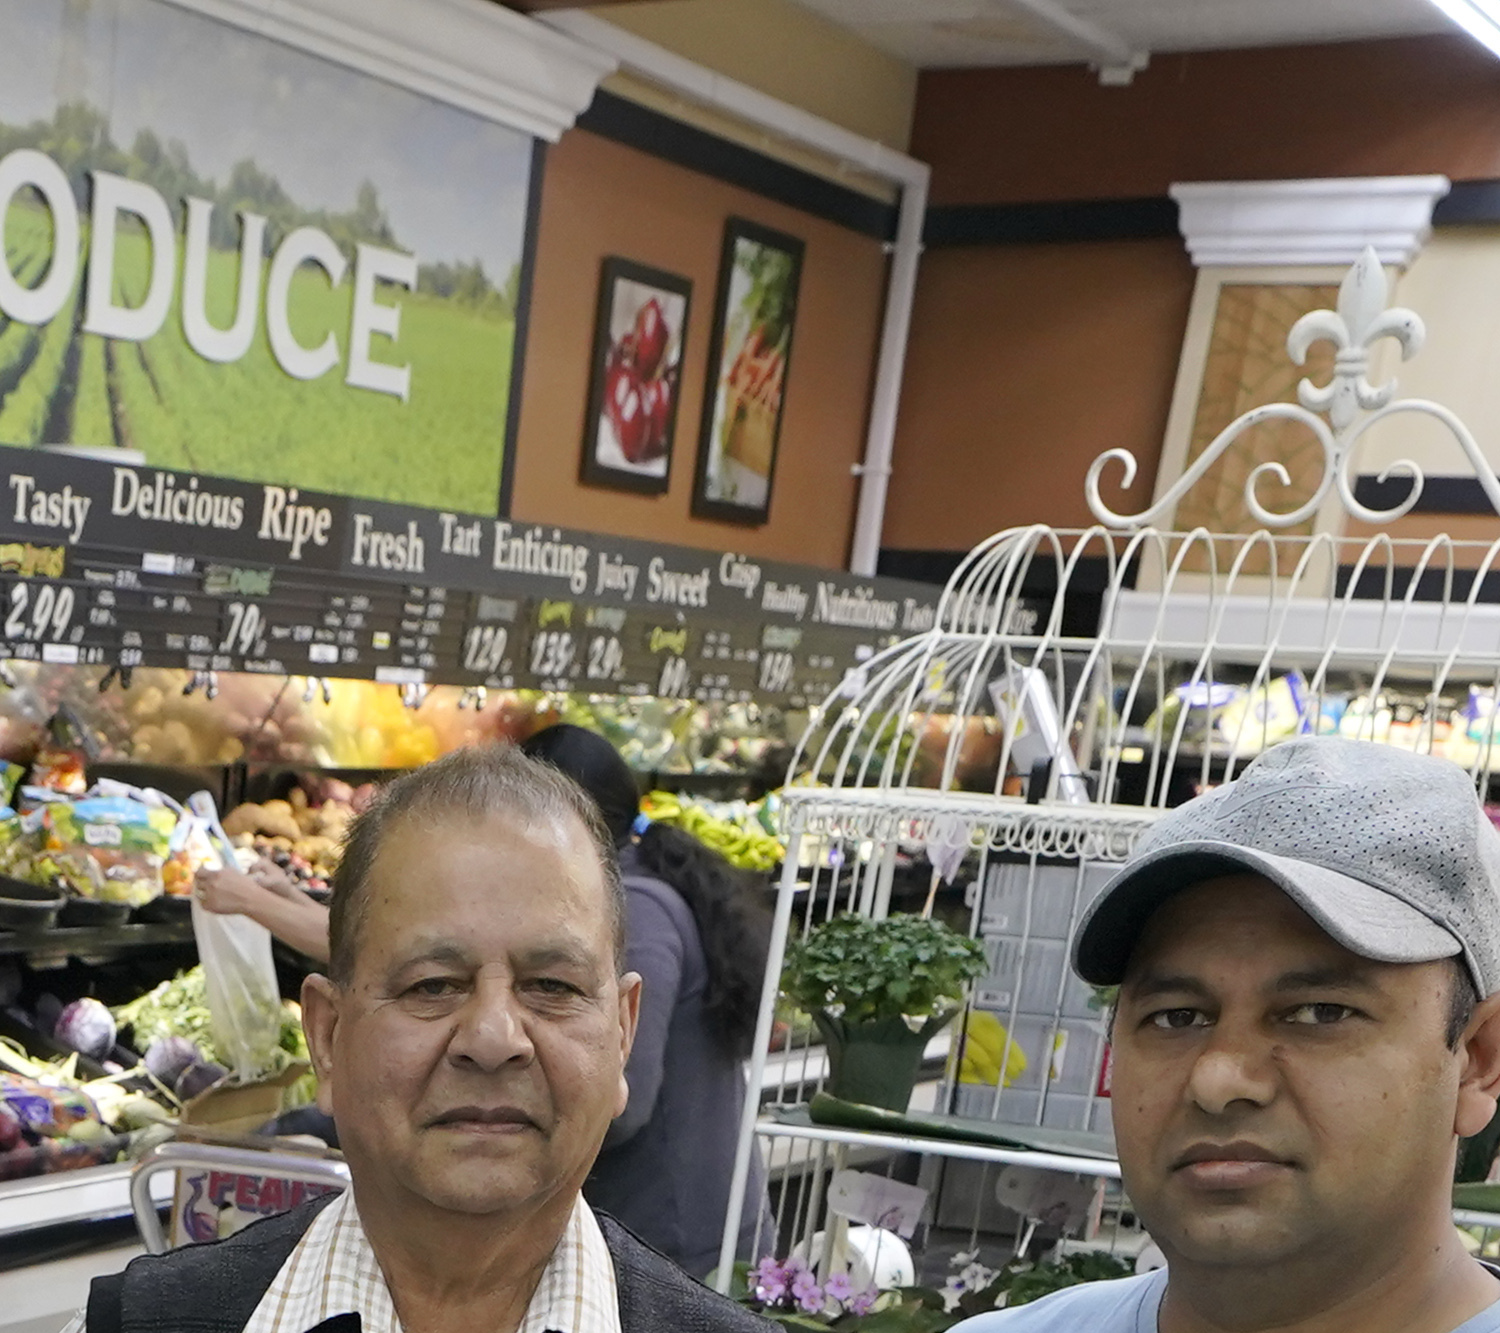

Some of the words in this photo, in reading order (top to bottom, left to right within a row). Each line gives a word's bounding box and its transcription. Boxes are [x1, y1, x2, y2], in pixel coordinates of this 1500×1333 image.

[10, 475, 92, 544] Tasty
[111, 466, 244, 531] Delicious
[258, 485, 333, 560] Ripe
[353, 514, 424, 574] Fresh
[439, 512, 482, 560] Tart
[493, 519, 589, 594] Enticing
[598, 553, 638, 602] Juicy
[646, 557, 711, 608] Sweet
[719, 551, 761, 599] Crisp
[811, 581, 898, 631] Nutritious
